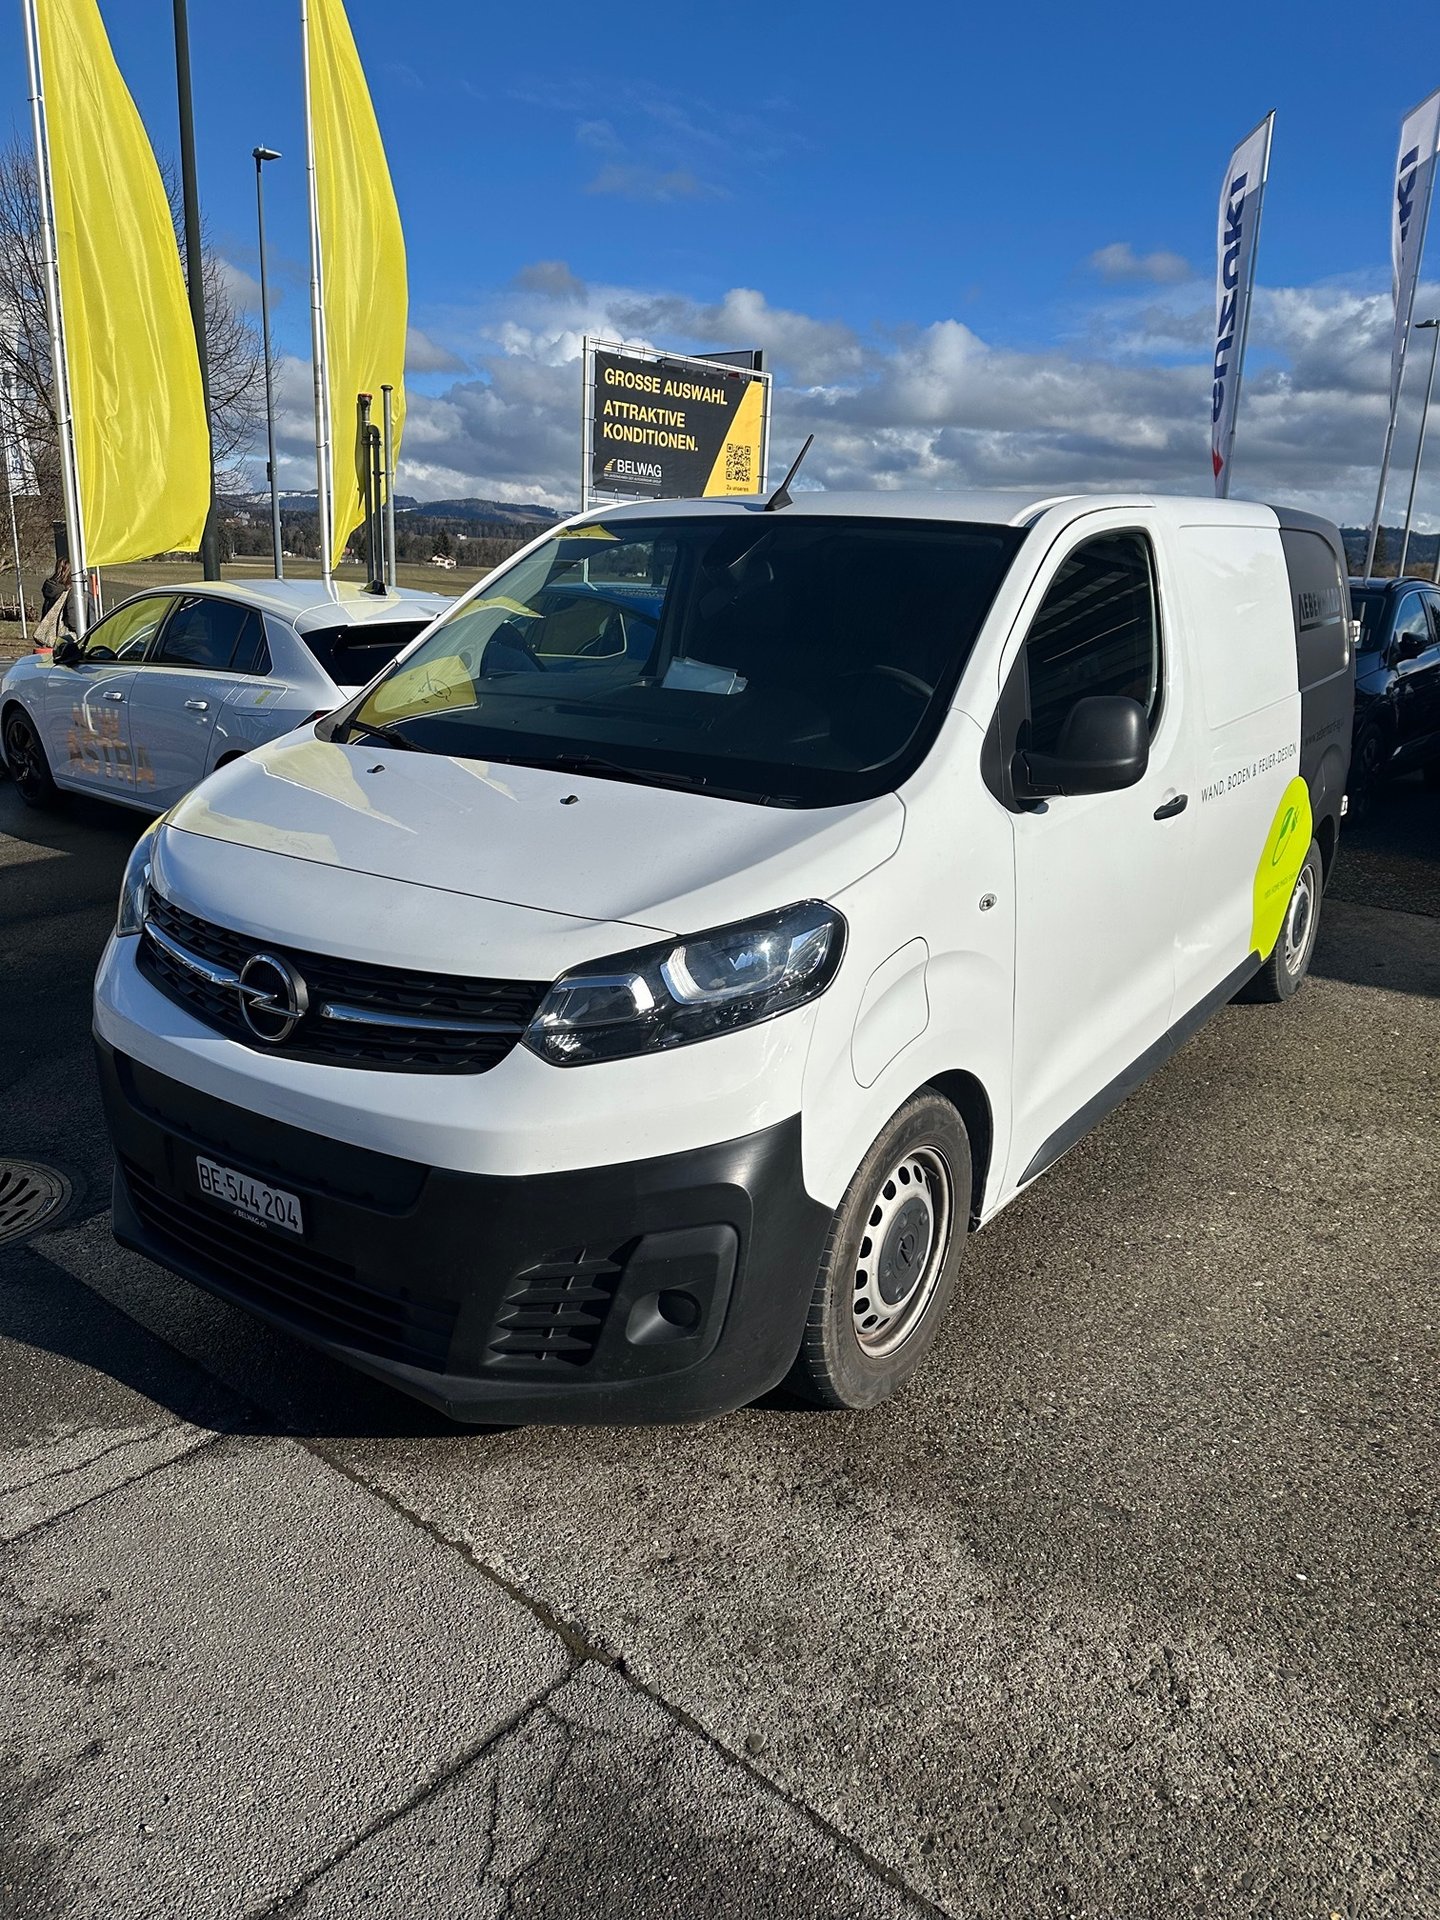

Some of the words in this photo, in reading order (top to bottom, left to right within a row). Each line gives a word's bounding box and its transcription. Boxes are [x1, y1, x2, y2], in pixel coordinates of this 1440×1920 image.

[604, 367, 661, 394] GROSSE
[663, 380, 728, 405] AUSWAHL
[603, 399, 686, 428] ATTRAKTIVE
[603, 421, 699, 451] KONDITIONEN.
[617, 459, 662, 478] BELWAG
[1227, 764, 1251, 791] BODEN
[1252, 763, 1257, 777] &
[1258, 742, 1297, 774] FEUER-DESIGN
